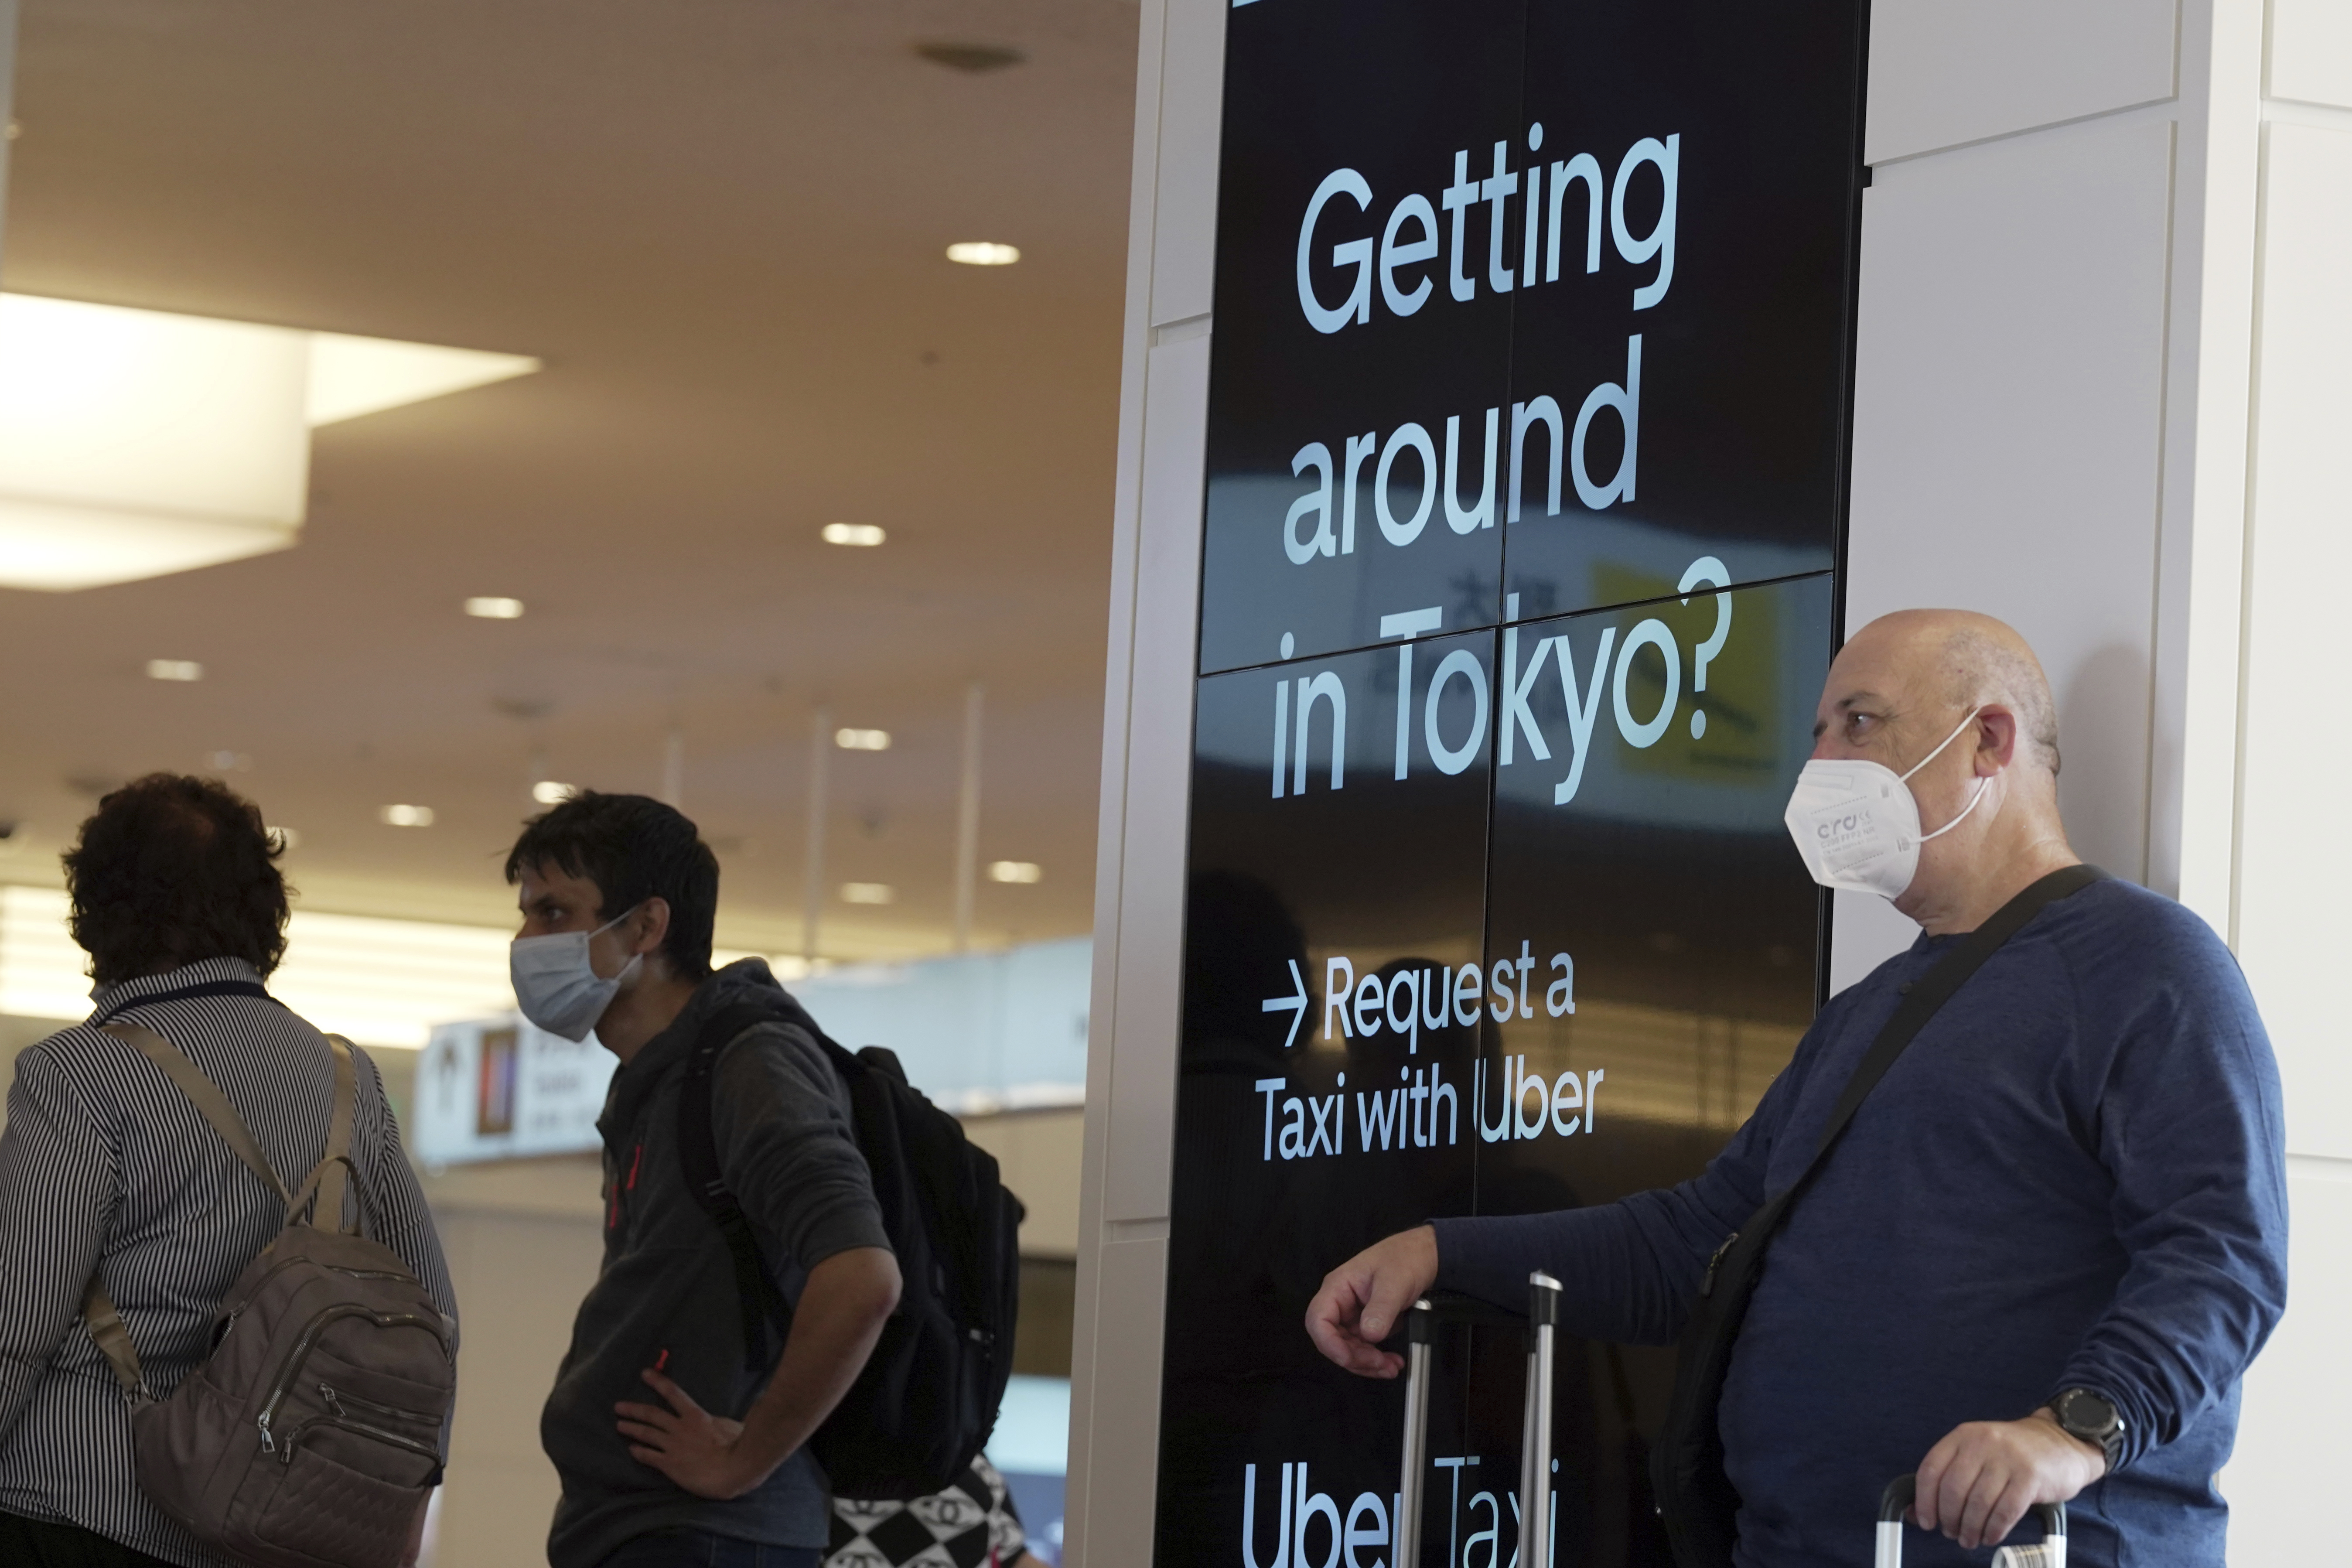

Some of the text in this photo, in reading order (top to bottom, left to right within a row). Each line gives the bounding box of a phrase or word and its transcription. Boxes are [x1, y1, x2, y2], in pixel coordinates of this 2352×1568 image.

[1296, 122, 1680, 334] Getting
[1283, 333, 1642, 566] around
[1271, 555, 1732, 806] in Tokyo?
[1324, 939, 1575, 1054] Request a
[1255, 1054, 1604, 1161] Taxi with Uber
